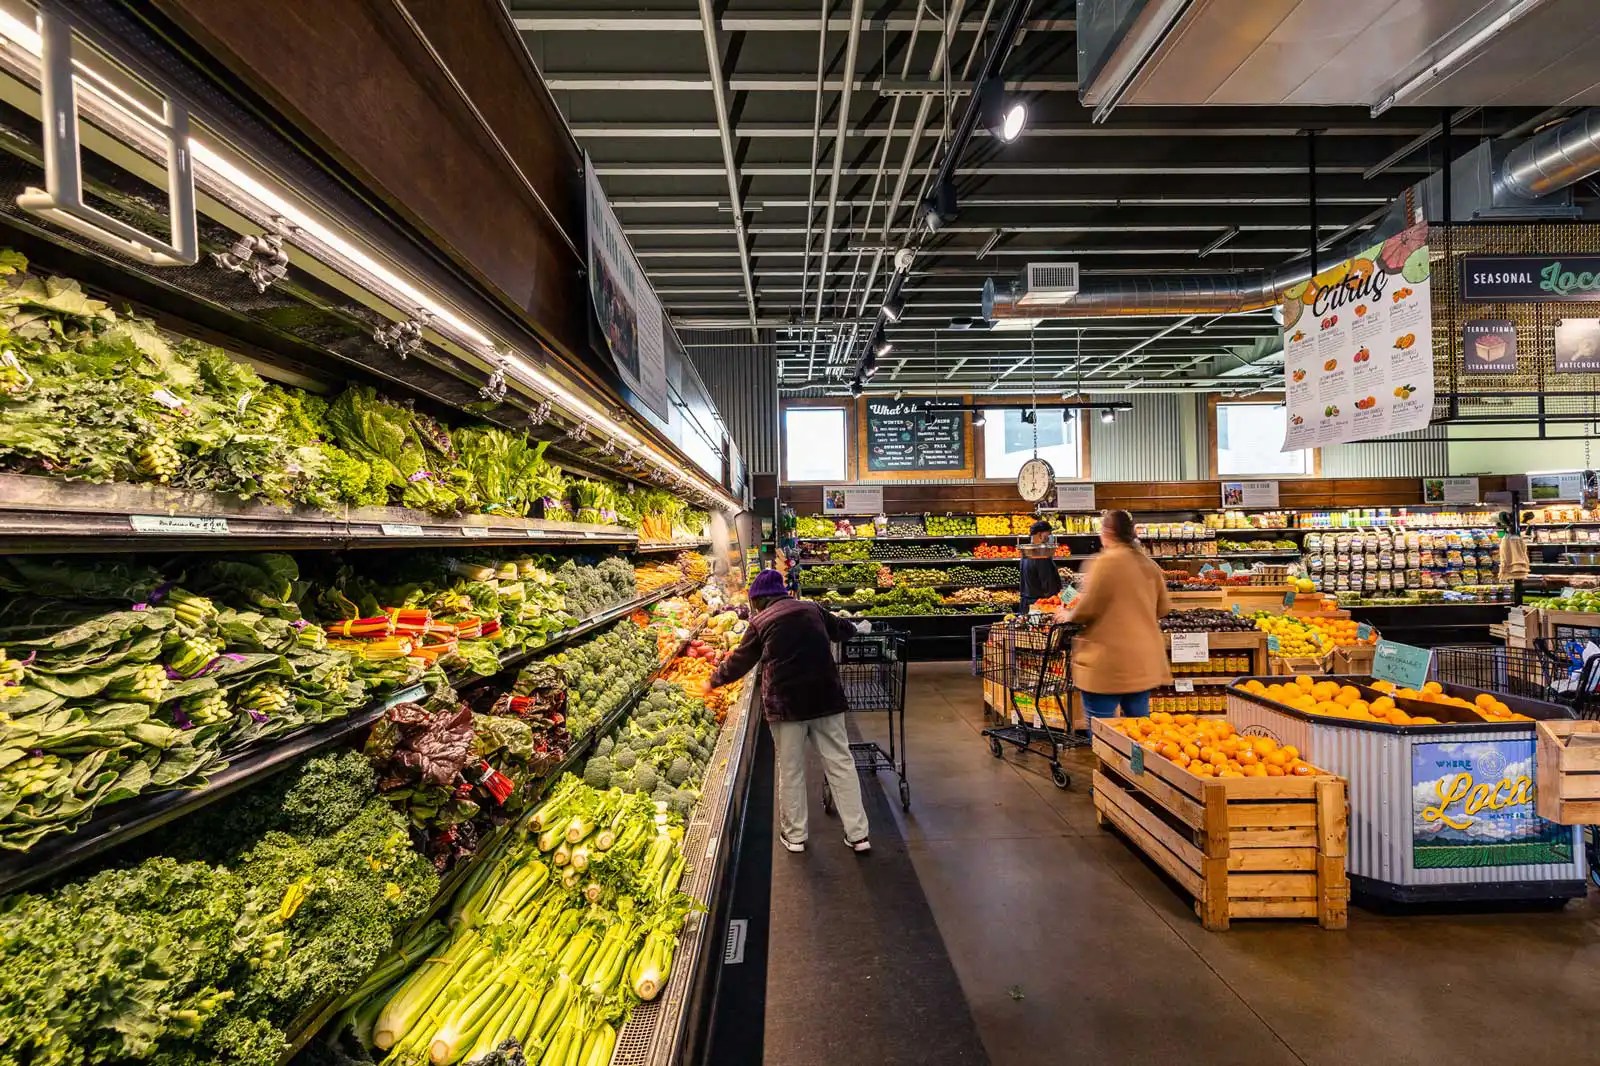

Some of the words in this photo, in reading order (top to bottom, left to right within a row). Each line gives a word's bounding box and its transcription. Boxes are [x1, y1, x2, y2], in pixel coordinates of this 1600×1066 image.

[1473, 272, 1533, 285] SEASONAL
[1312, 268, 1389, 318] Citrus
[1466, 326, 1489, 334] TERRA
[1491, 326, 1515, 334] FIRMA
[1467, 363, 1516, 371] STRAWBERRIES
[870, 403, 910, 416] What's
[1436, 759, 1473, 771] WHERE
[1421, 771, 1534, 831] Loca
